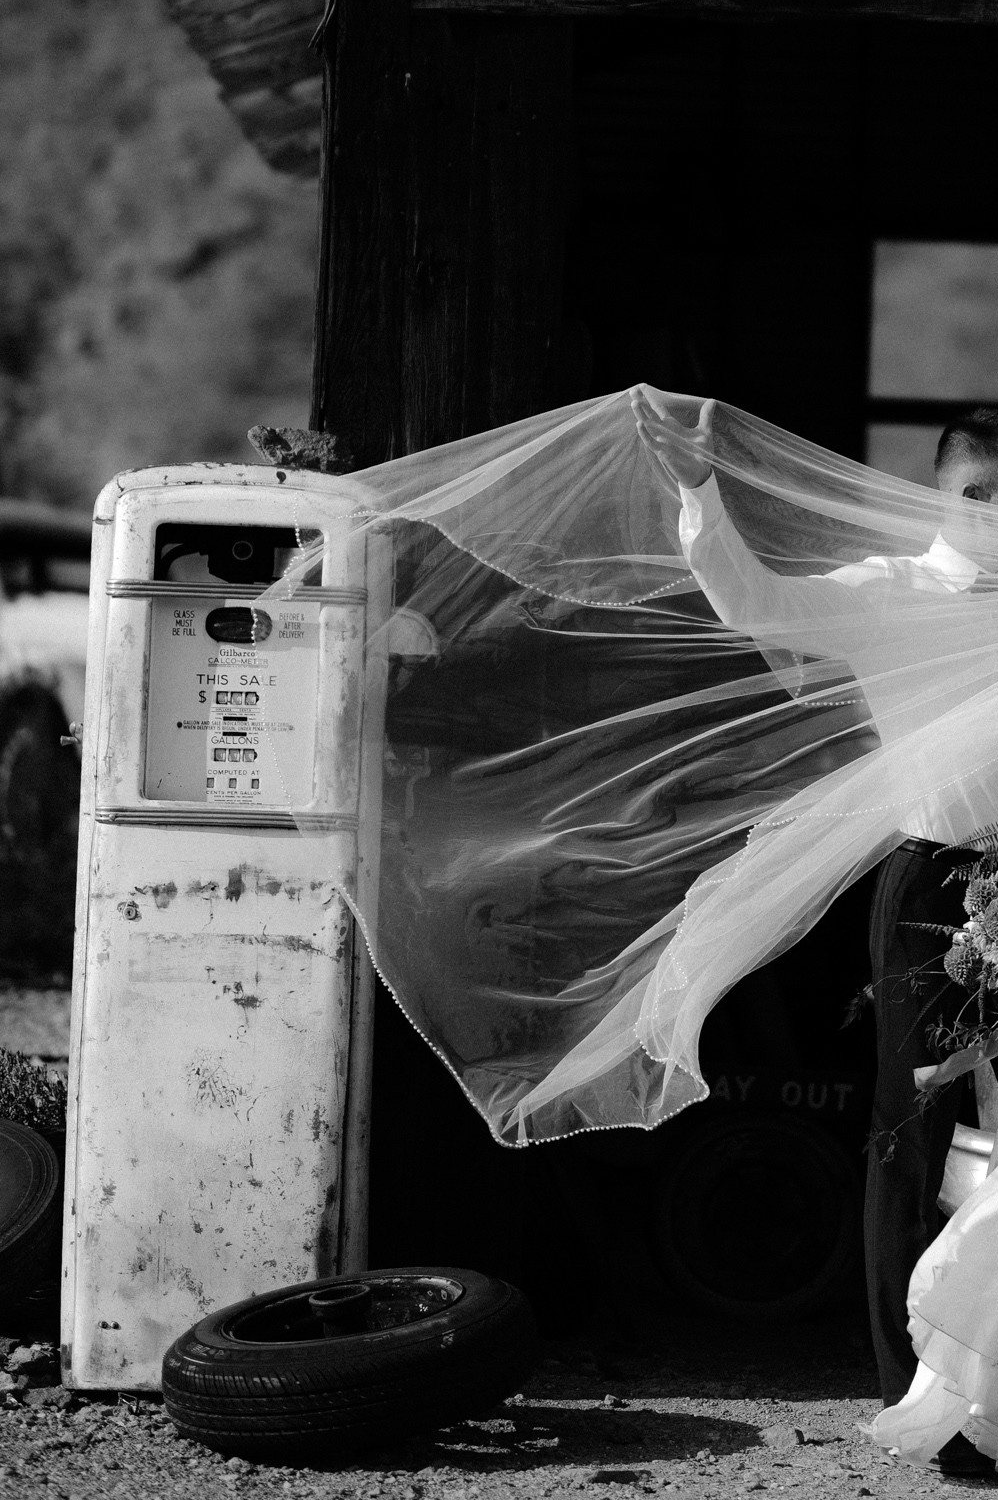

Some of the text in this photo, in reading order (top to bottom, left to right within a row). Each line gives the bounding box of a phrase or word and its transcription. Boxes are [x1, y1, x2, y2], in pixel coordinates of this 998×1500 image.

[173, 609, 195, 619] GLASS
[279, 612, 300, 621] BEFORE
[175, 619, 193, 627] MUST
[283, 622, 302, 630] AFTER
[172, 627, 197, 637] BE FULL
[278, 630, 305, 639] DELIVERY
[219, 648, 256, 657] Gilbarco
[196, 673, 278, 687] THIS SALE
[198, 690, 207, 703] $
[211, 736, 259, 745] GALLONS
[780, 1079, 854, 1112] OUT
